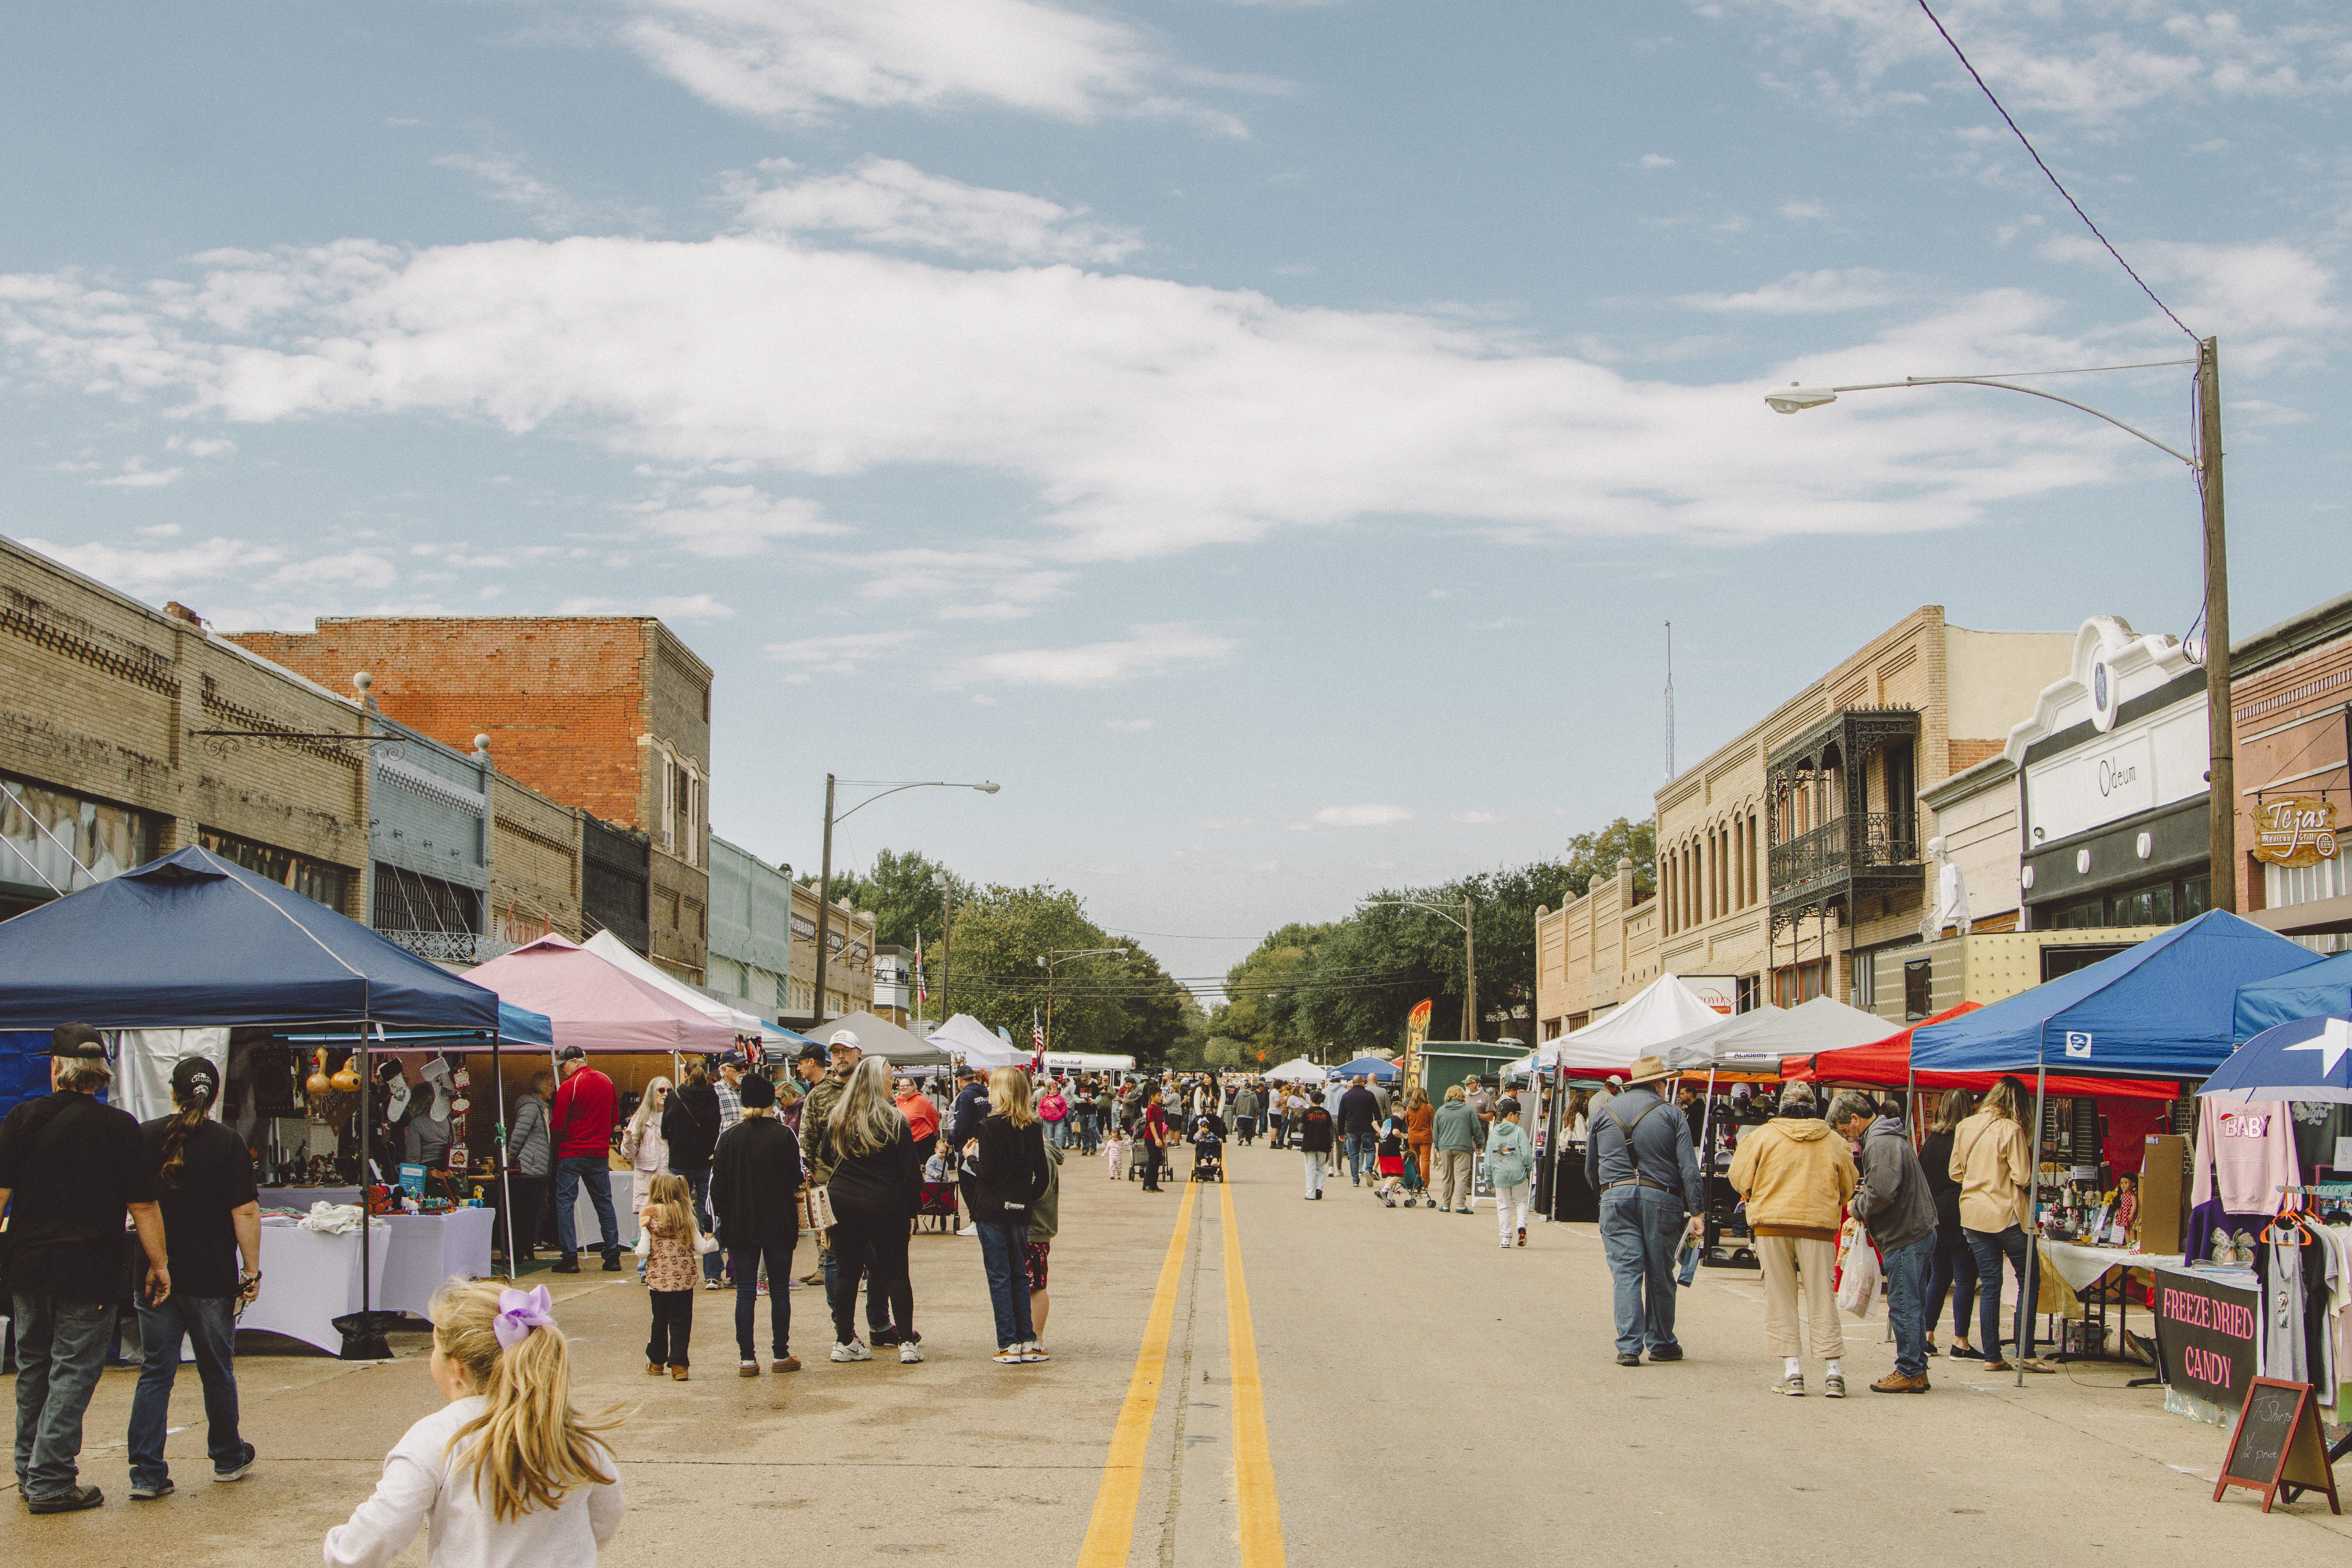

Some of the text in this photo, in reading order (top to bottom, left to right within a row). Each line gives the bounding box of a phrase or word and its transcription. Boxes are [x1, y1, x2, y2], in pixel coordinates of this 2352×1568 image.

[2099, 756, 2135, 797] Odeum
[2261, 835, 2291, 843] Mexican
[2267, 801, 2328, 858] Tejas
[791, 917, 815, 937] HUBBARD
[191, 1076, 212, 1085] CHAMPS
[2225, 1116, 2272, 1138] BABY
[2163, 1288, 2254, 1340] FREEZE DRIED
[2185, 1345, 2231, 1388] CANDY
[2254, 1450, 2278, 1468] price
